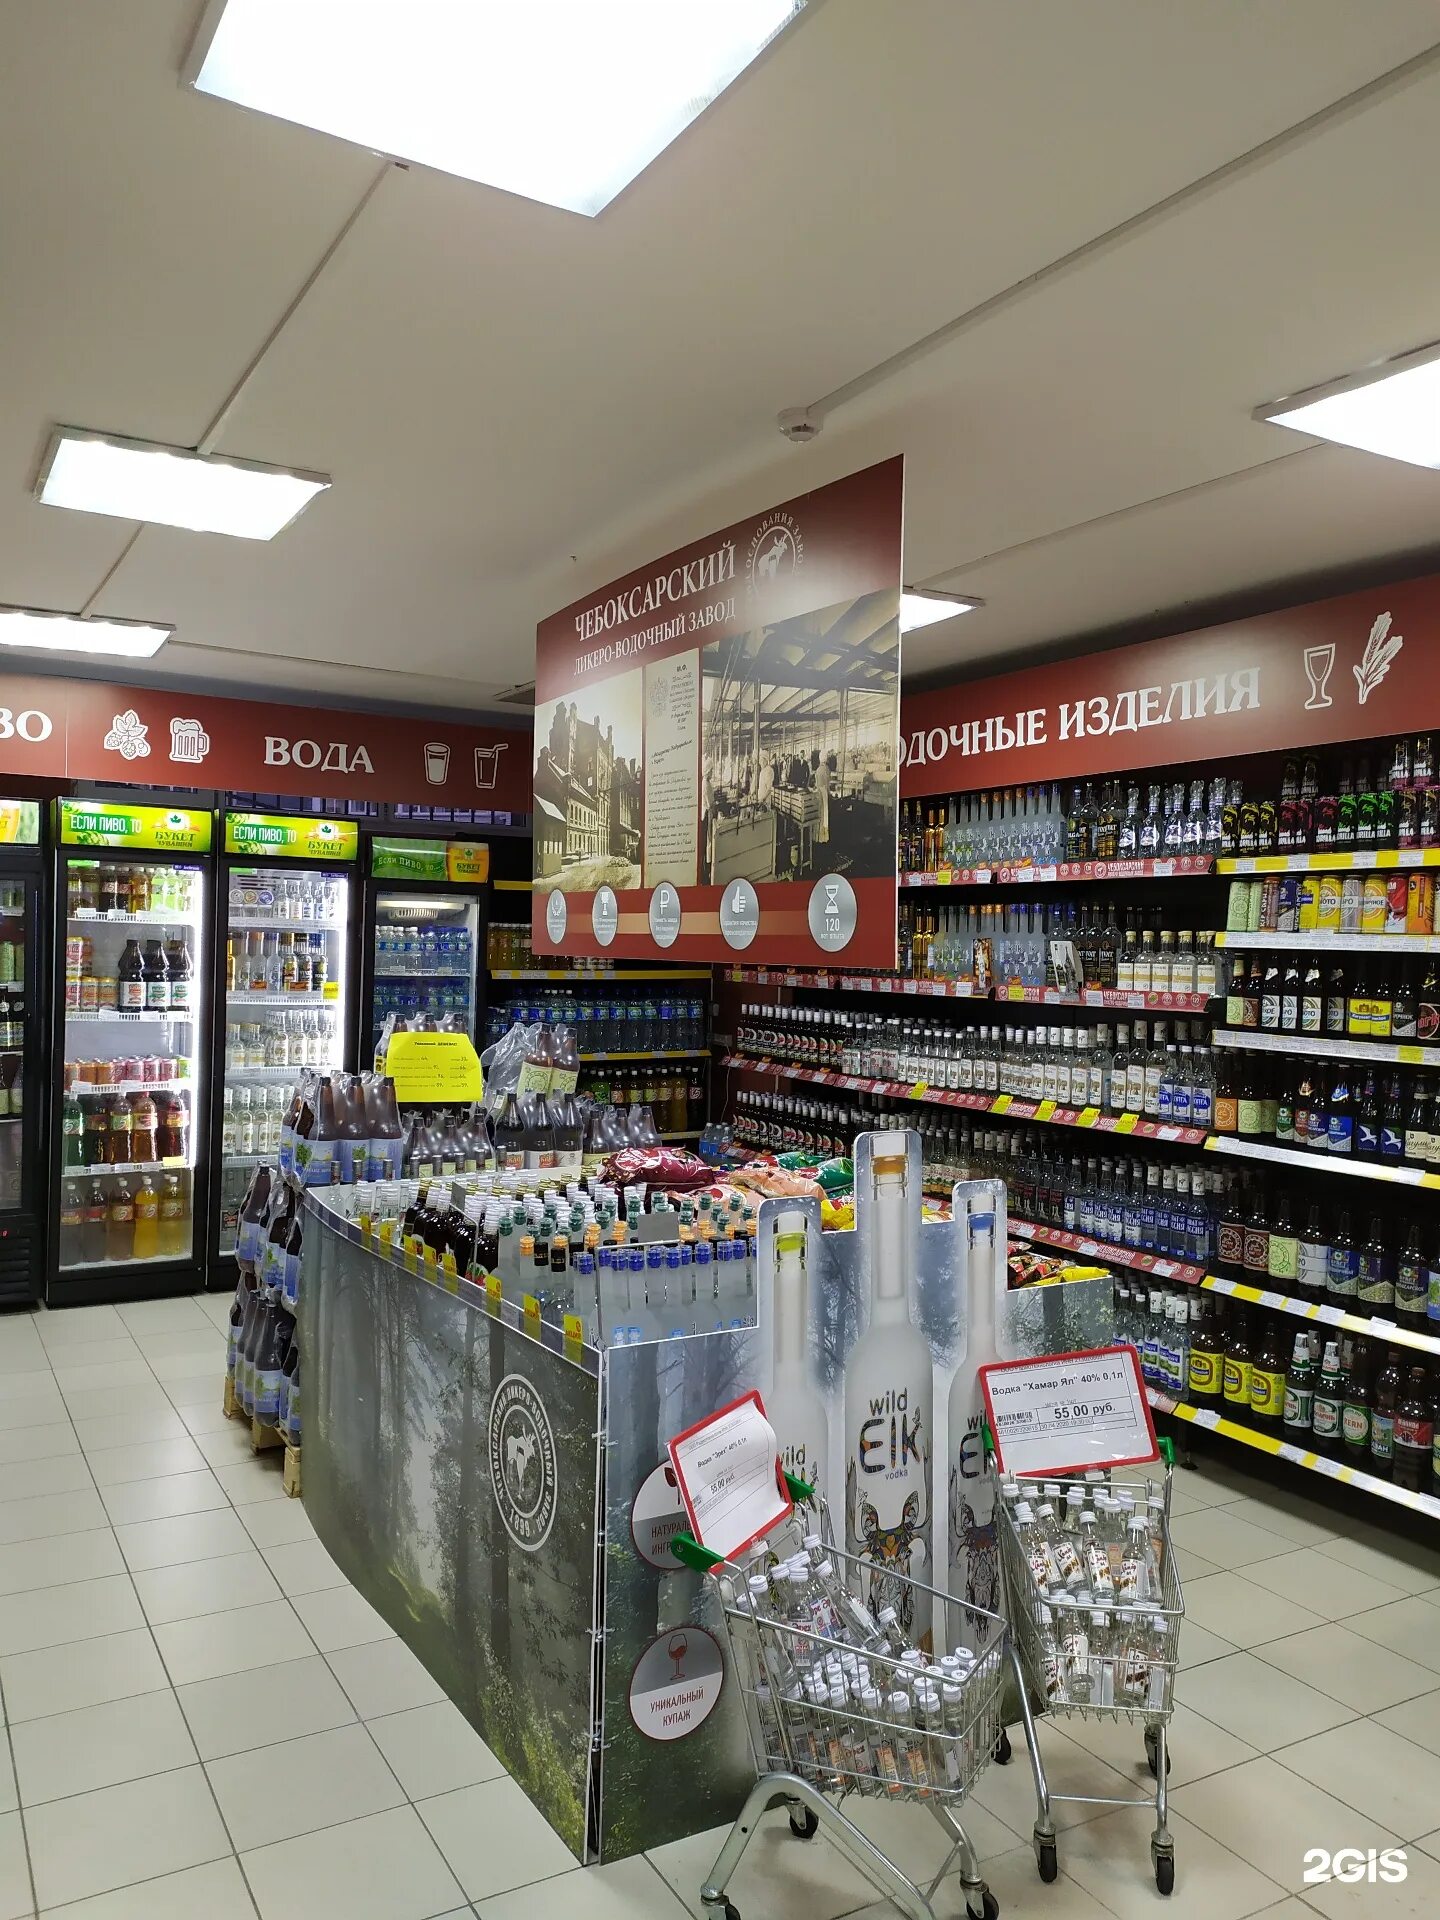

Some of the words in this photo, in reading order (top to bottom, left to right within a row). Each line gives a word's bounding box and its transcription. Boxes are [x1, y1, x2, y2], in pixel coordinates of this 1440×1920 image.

[575, 540, 737, 642] ЧЕБОКСАРСКИЙ
[574, 613, 686, 676] ЛИКЕРО-ВОДОЧНЫЙ
[688, 597, 737, 632] ЗАВОД
[1059, 666, 1261, 741] ИЗДЕЛИЯ
[263, 735, 376, 774] ВОДА
[70, 813, 97, 831] ЕСЛИ
[99, 815, 128, 834] ПИВО,
[232, 825, 257, 841] ЕСЛИ
[258, 827, 284, 844] ПИВО,
[155, 831, 196, 842] БУКЕТ
[307, 840, 344, 851] БУКЕТ
[825, 917, 841, 933] 120
[991, 1386, 1021, 1396] Водка
[1022, 1380, 1058, 1391] "Хамар
[1060, 1375, 1079, 1386] Ял"
[1081, 1373, 1101, 1384] 40%
[1102, 1371, 1124, 1382] 0,1л
[869, 1387, 909, 1417] wild
[1054, 1404, 1089, 1421] 55,00
[1092, 1401, 1116, 1416] руб.
[506, 1385, 554, 1487] ЛИКЕРО-ВОДОЧНЫЙ
[859, 1406, 922, 1474] Elk
[781, 1443, 806, 1466] ild
[884, 1469, 909, 1481] vodka
[508, 1507, 531, 1538] 1899
[649, 1684, 705, 1714] УНИКАЛЬНЫЙ
[662, 1708, 692, 1728] КУПАЖ
